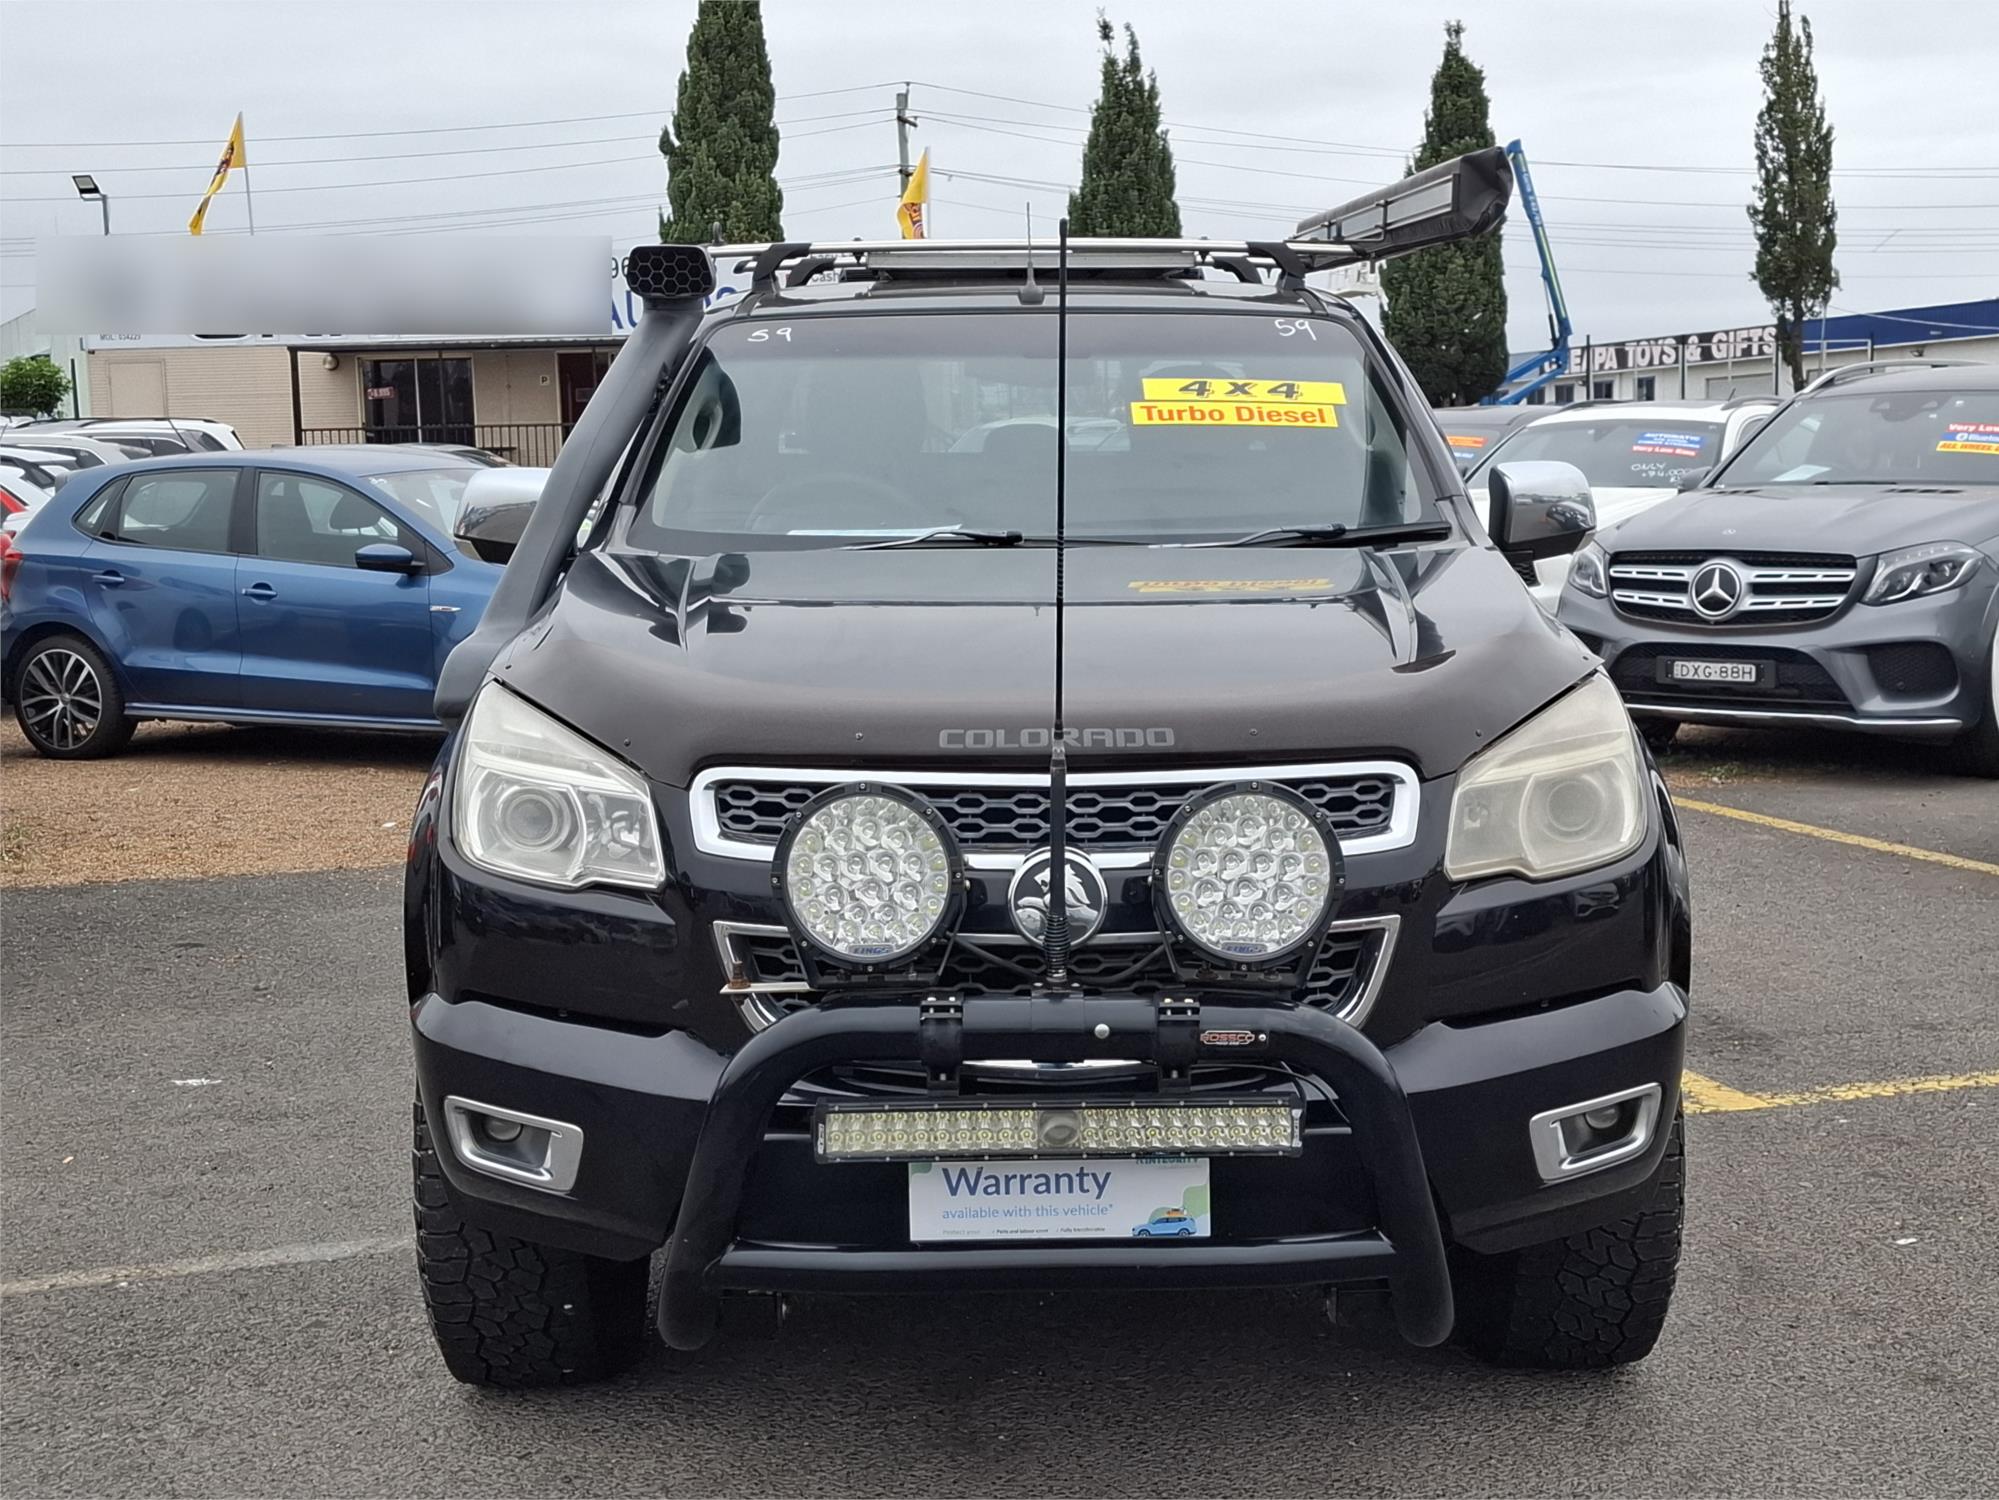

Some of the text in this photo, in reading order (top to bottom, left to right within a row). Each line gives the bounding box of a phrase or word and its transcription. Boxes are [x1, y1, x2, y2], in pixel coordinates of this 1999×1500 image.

[747, 327, 792, 342] 59
[1274, 319, 1317, 341] 59
[1625, 337, 1677, 368] TOYS
[1686, 335, 1701, 362] &
[1711, 326, 1777, 360] GIFTS
[1140, 405, 1327, 424] Turbo Diesel
[1948, 423, 1976, 432] Very
[939, 727, 1176, 749] COLORADO
[941, 1166, 1112, 1200] Warranty
[942, 1206, 999, 1219] available
[1003, 1205, 1032, 1218] with
[1035, 1204, 1059, 1217] this
